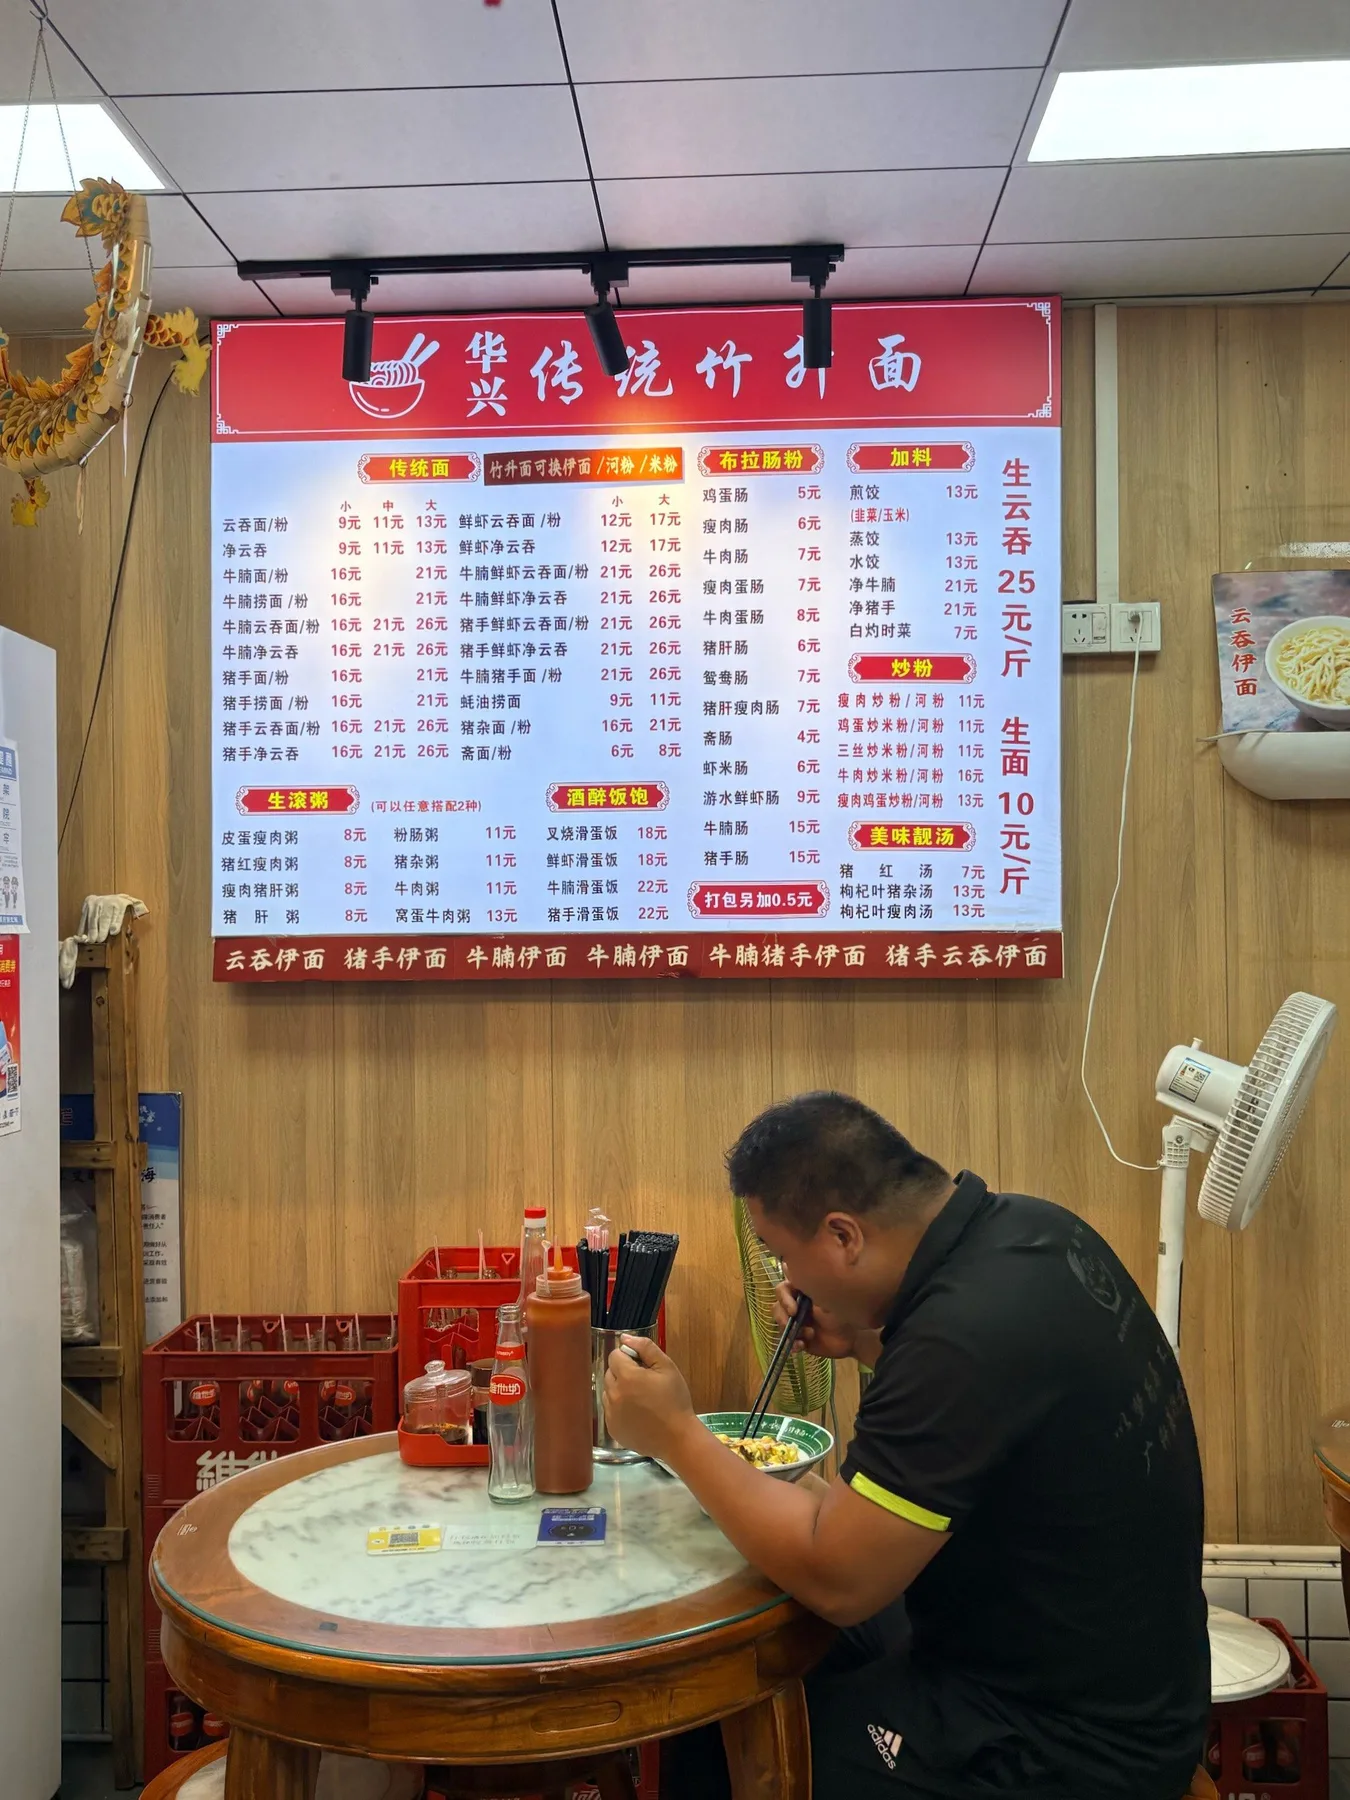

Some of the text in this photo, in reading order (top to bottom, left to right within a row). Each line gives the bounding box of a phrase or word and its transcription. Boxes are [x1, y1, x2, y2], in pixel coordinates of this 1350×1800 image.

[465, 330, 508, 417] 华兴
[720, 450, 803, 470] 布拉肠粉
[891, 448, 931, 466] 加料
[390, 459, 449, 477] 传统面
[612, 494, 669, 507] 小 大
[703, 485, 821, 503] 鸡蛋肠 5元
[850, 485, 978, 500] 煎饺 13元
[340, 499, 436, 512] 小 中 大
[223, 515, 447, 532] 云吞面/粉 9元 13元
[650, 512, 681, 526] 17元
[703, 518, 748, 534] 瘦肉肠
[850, 531, 978, 546] 蒸饺 13元
[223, 541, 404, 558] 净云吞 11元
[459, 539, 632, 555] 鲜虾净云吞 12元
[703, 547, 821, 564] 牛肉肠 7元
[850, 554, 879, 569] 水饺
[223, 567, 361, 584] 牛腩面/粉 16元
[460, 564, 632, 581] 牛腩鲜虾云吞面/粉 21元
[703, 579, 764, 595] 瘦肉蛋肠
[850, 577, 977, 593] 净牛腩 21元
[331, 592, 361, 606] 16元
[460, 590, 632, 606] 牛腩鲜虾净云吞 21元
[849, 600, 976, 616] 净猪手 21元
[460, 615, 681, 632] 猪手鲜虾云吞面/粉 26元
[703, 608, 820, 625] 牛肉蛋肠 8元
[222, 617, 448, 635] 牛腩云吞面/粉 16元 26元
[851, 623, 977, 640] 白灼时菜 7元
[222, 643, 405, 660] 牛腩净云吞 21元
[460, 642, 632, 658] 猪手鲜虾净云吞 21元
[703, 640, 748, 655] 猪肝肠
[1230, 608, 1258, 696] 云吞伊面
[601, 667, 632, 681] 21元
[892, 659, 932, 677] 炒粉
[223, 669, 362, 685] 猪手面/粉 16元
[703, 669, 820, 685] 鸳鸯肠 7元
[332, 694, 362, 708] 16元
[461, 693, 633, 709] 蚝油捞面 9元
[703, 699, 820, 716] 猪肝瘦肉肠 7元
[838, 692, 984, 708] 瘦肉炒粉/河粉 11元
[223, 719, 448, 736] 猪手云吞面/粉 16元 26元
[650, 718, 681, 732] 21元
[838, 718, 984, 733] 鸡蛋炒米粉/河粉 11元
[704, 729, 820, 746] 斋肠 4元
[223, 744, 406, 761] 猪手净云吞 21元
[462, 744, 633, 761] 斋面/粉 6元
[838, 743, 984, 758] 三丝炒米粉/河粉 11元
[703, 760, 747, 776] 虾米肠
[838, 768, 984, 783] 牛肉炒米粉/河粉 16元
[268, 791, 328, 809] 生滚粥
[568, 787, 648, 806] 酒醉饭饱
[704, 790, 820, 806] 游水鲜虾肠 9元
[838, 793, 983, 808] 瘦肉鸡蛋炒粉/河粉 13元
[371, 800, 481, 813] (可以任意搭配2种)
[394, 826, 516, 842] 粉肠粥 11元
[547, 826, 667, 841] 叉烧滑蛋饭 18元
[704, 820, 820, 836] 牛腩肠 15元
[871, 827, 953, 845] 美味靓汤
[222, 828, 366, 845] 皮蛋瘦肉粥 8元
[221, 855, 367, 871] 猪红瘦肉粥 8元
[395, 853, 516, 869] 猪杂粥 11元
[547, 853, 667, 868] 鲜虾滑蛋饭 18元
[704, 850, 820, 866] 猪手肠 15元
[962, 865, 985, 879] 7元
[222, 882, 367, 898] 瘦肉猪肝粥 8元
[395, 881, 517, 896] 牛肉粥 11元
[547, 880, 668, 895] 牛腩滑蛋饭 22元
[840, 884, 985, 899] 枸杞叶猪杂汤 13元
[705, 892, 812, 908] 打包另加0.5元
[345, 909, 367, 922] 8元
[396, 908, 517, 923] 窝蛋牛肉粥 13元
[548, 906, 668, 922] 猪手滑蛋饭 22元
[840, 904, 985, 919] 枸杞叶瘦肉汤 13元
[226, 944, 1047, 971] 云吞伊面 猪手伊面 牛腩伊面 牛腩伊面 牛腩猪手伊面 猪手云吞伊面
[867, 1724, 896, 1770] adidas
